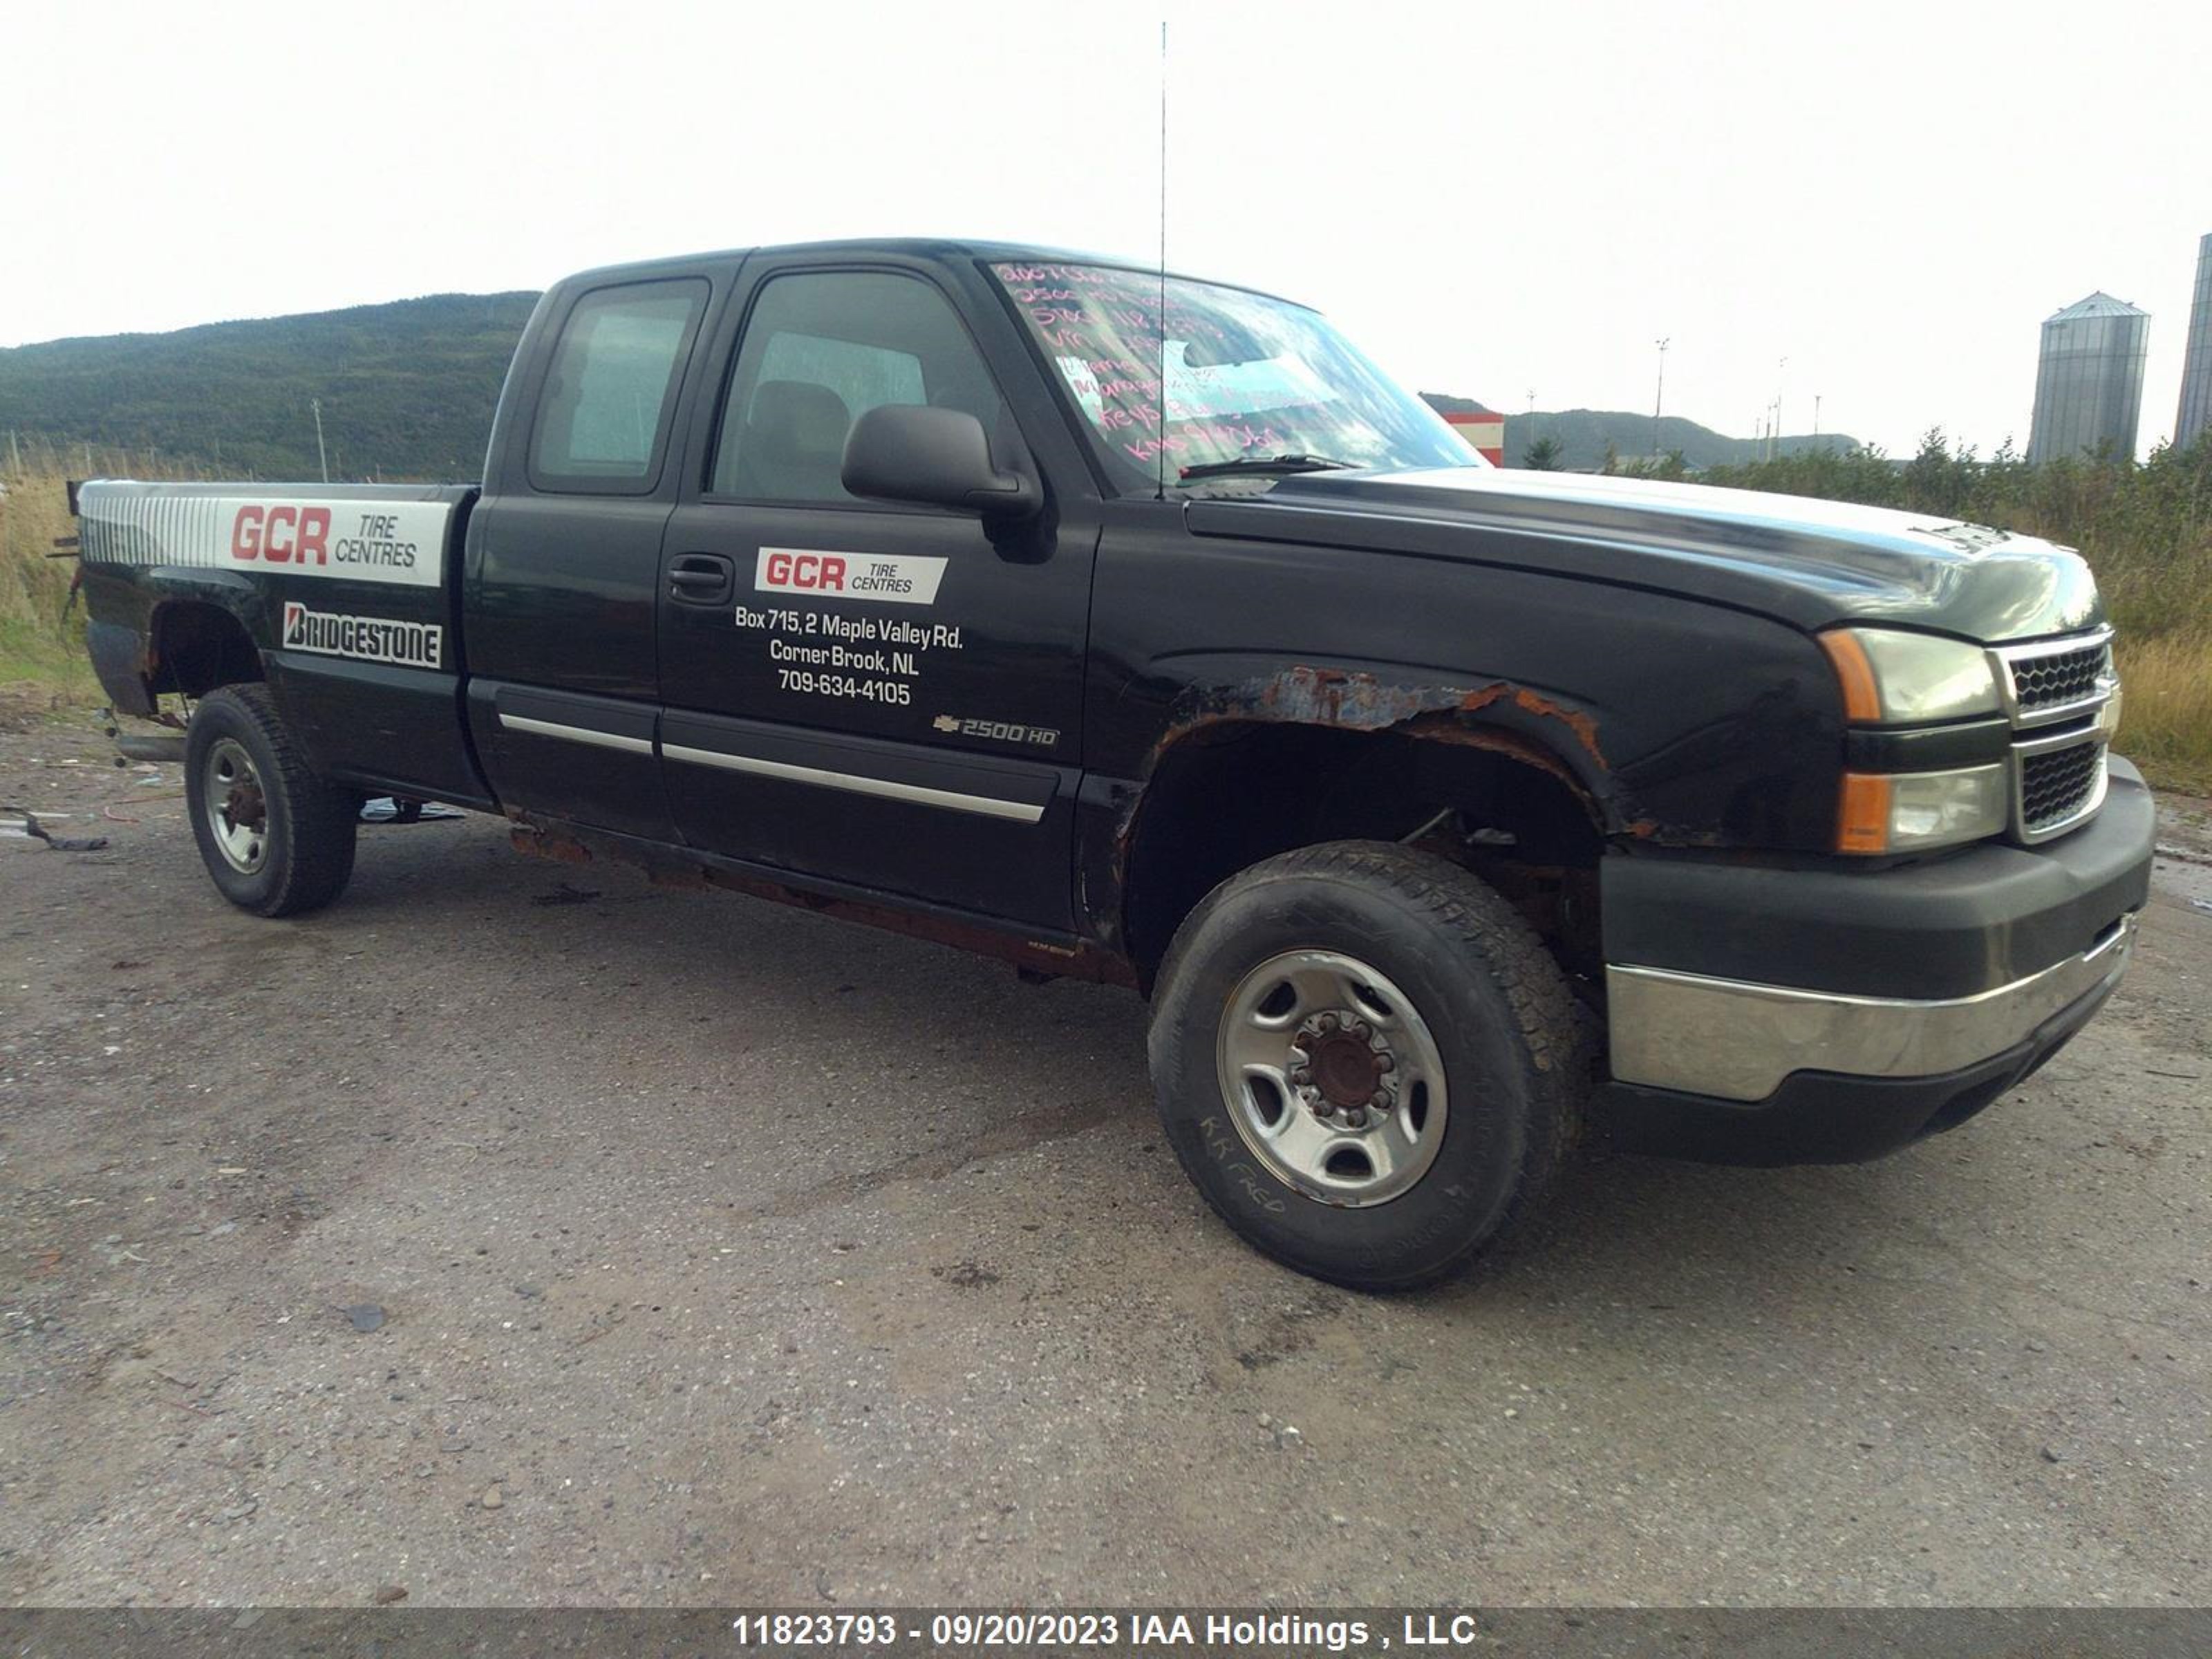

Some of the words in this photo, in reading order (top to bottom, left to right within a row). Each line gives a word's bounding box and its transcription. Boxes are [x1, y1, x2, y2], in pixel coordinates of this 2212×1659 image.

[232, 505, 331, 565] GCR
[359, 514, 398, 538] TIRE
[335, 538, 417, 568] CENTRES
[766, 554, 847, 591] GCR
[852, 576, 913, 593] CENTRES
[870, 563, 899, 578] TIRE
[735, 606, 765, 630] Box
[768, 609, 803, 634] 715,
[805, 613, 817, 634] 2
[823, 614, 875, 644] Maple
[879, 619, 931, 651] Valley
[934, 625, 964, 649] Rd.
[770, 639, 830, 664] Corner
[832, 646, 890, 675] Brook,
[892, 651, 920, 676] NL
[778, 669, 911, 705] 709-634-4105
[963, 718, 1026, 742] 2500
[1028, 730, 1056, 744] HD
